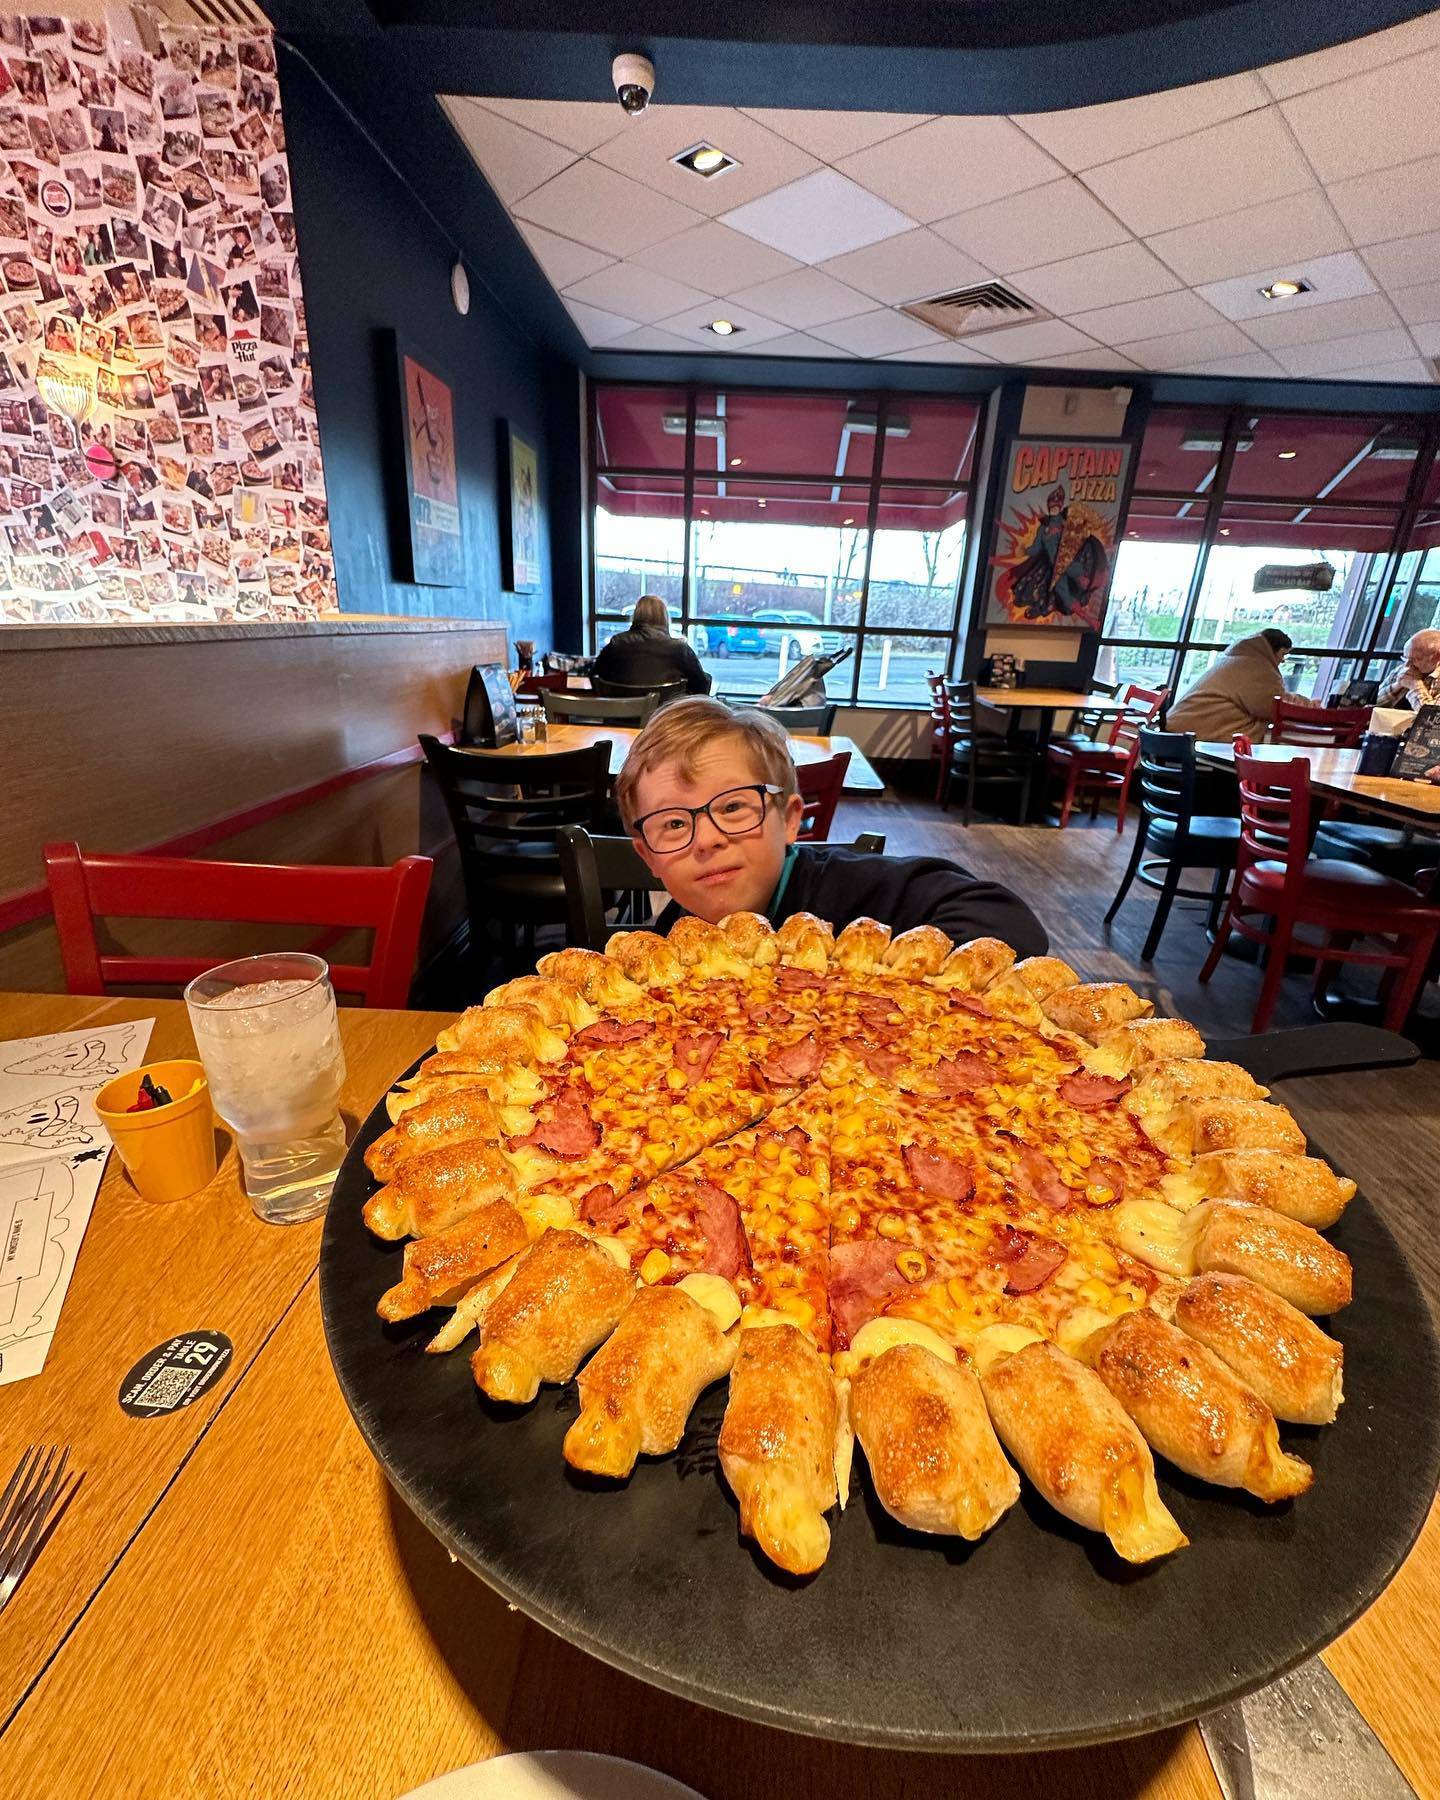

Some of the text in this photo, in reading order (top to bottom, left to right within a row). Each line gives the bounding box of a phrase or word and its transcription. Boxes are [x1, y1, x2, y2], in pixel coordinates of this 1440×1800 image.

[231, 341, 258, 353] Pizza
[235, 351, 256, 362] Hut
[1012, 446, 1123, 494] CAPTAIN
[1069, 479, 1117, 502] PIZZA
[141, 1358, 168, 1381] ORDER
[166, 1338, 183, 1351] PAY
[172, 1339, 197, 1360] TABLE
[184, 1341, 219, 1365] 29
